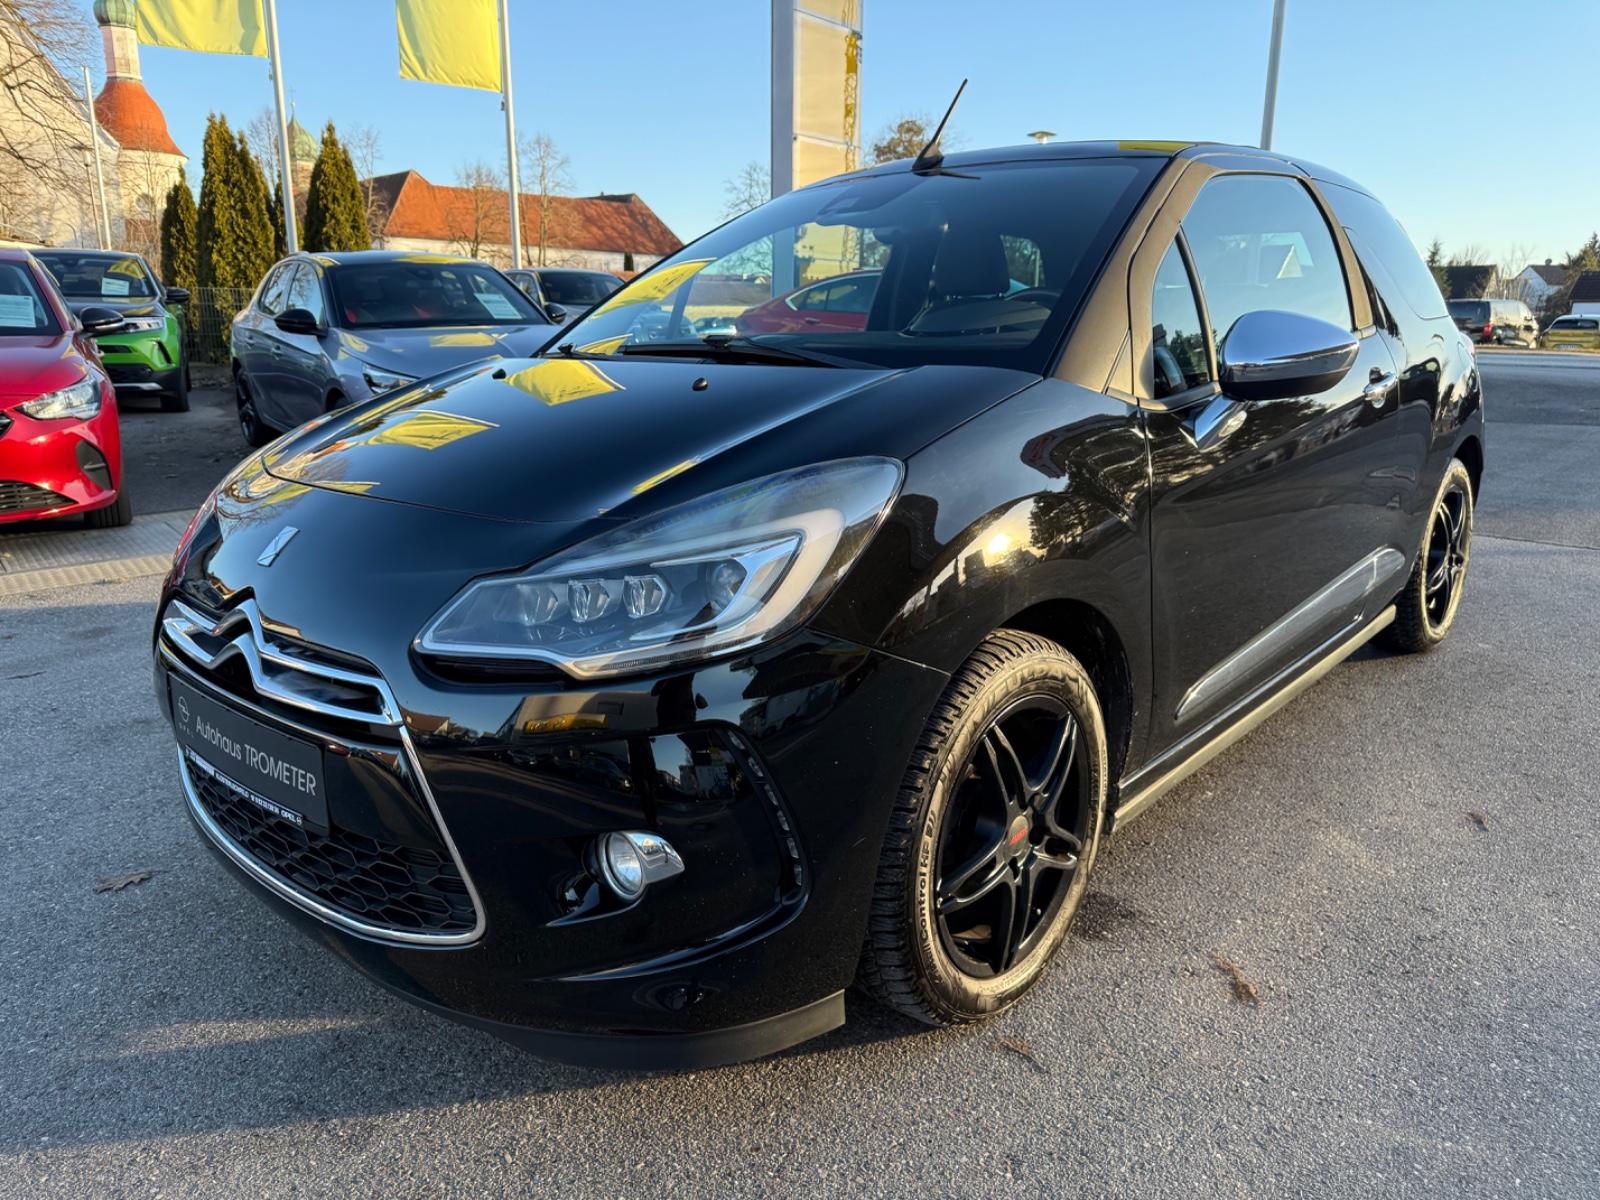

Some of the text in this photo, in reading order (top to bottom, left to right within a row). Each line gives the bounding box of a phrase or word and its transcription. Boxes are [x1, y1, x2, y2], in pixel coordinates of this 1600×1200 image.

[196, 715, 242, 760] Autohaus
[244, 744, 317, 796] TROMETER
[919, 871, 928, 941] Control
